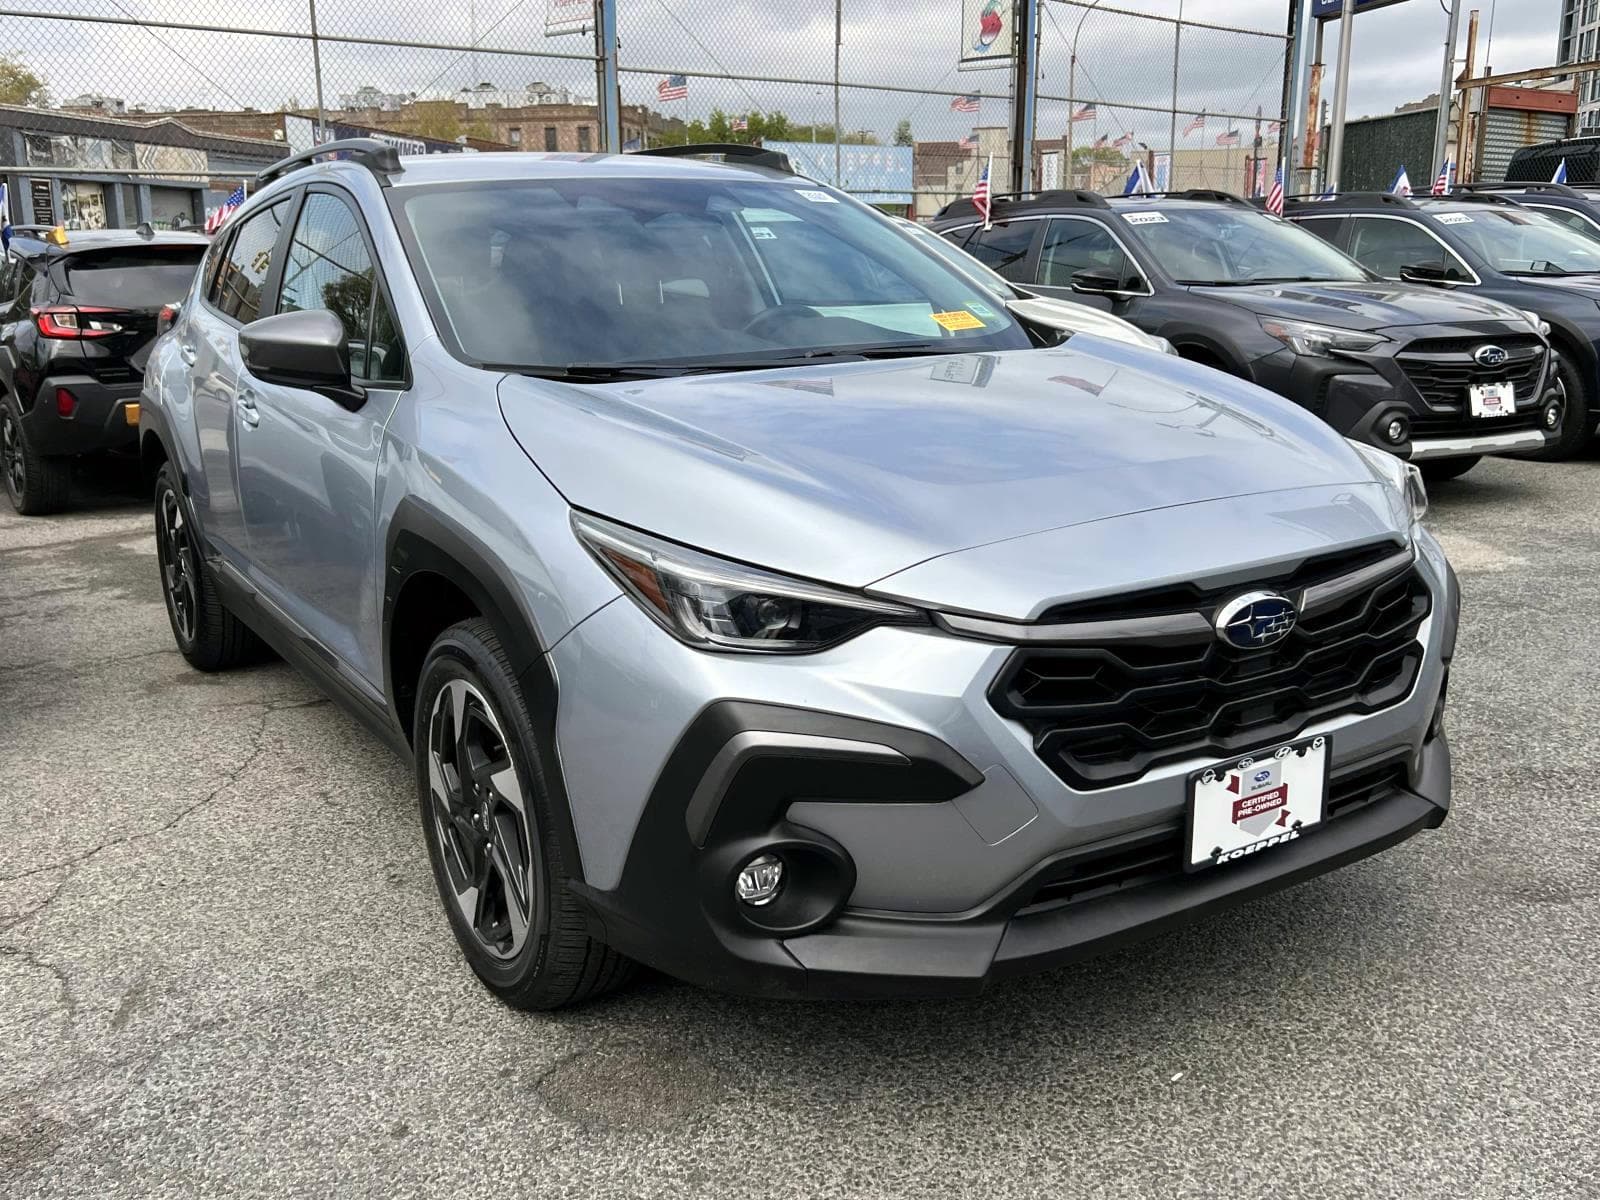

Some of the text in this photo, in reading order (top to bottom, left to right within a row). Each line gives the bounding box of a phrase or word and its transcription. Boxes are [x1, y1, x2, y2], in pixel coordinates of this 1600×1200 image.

[1238, 798, 1282, 817] PRE-OWNED
[1242, 791, 1279, 808] CERTIFIED
[1216, 830, 1300, 864] KOEPPEL
